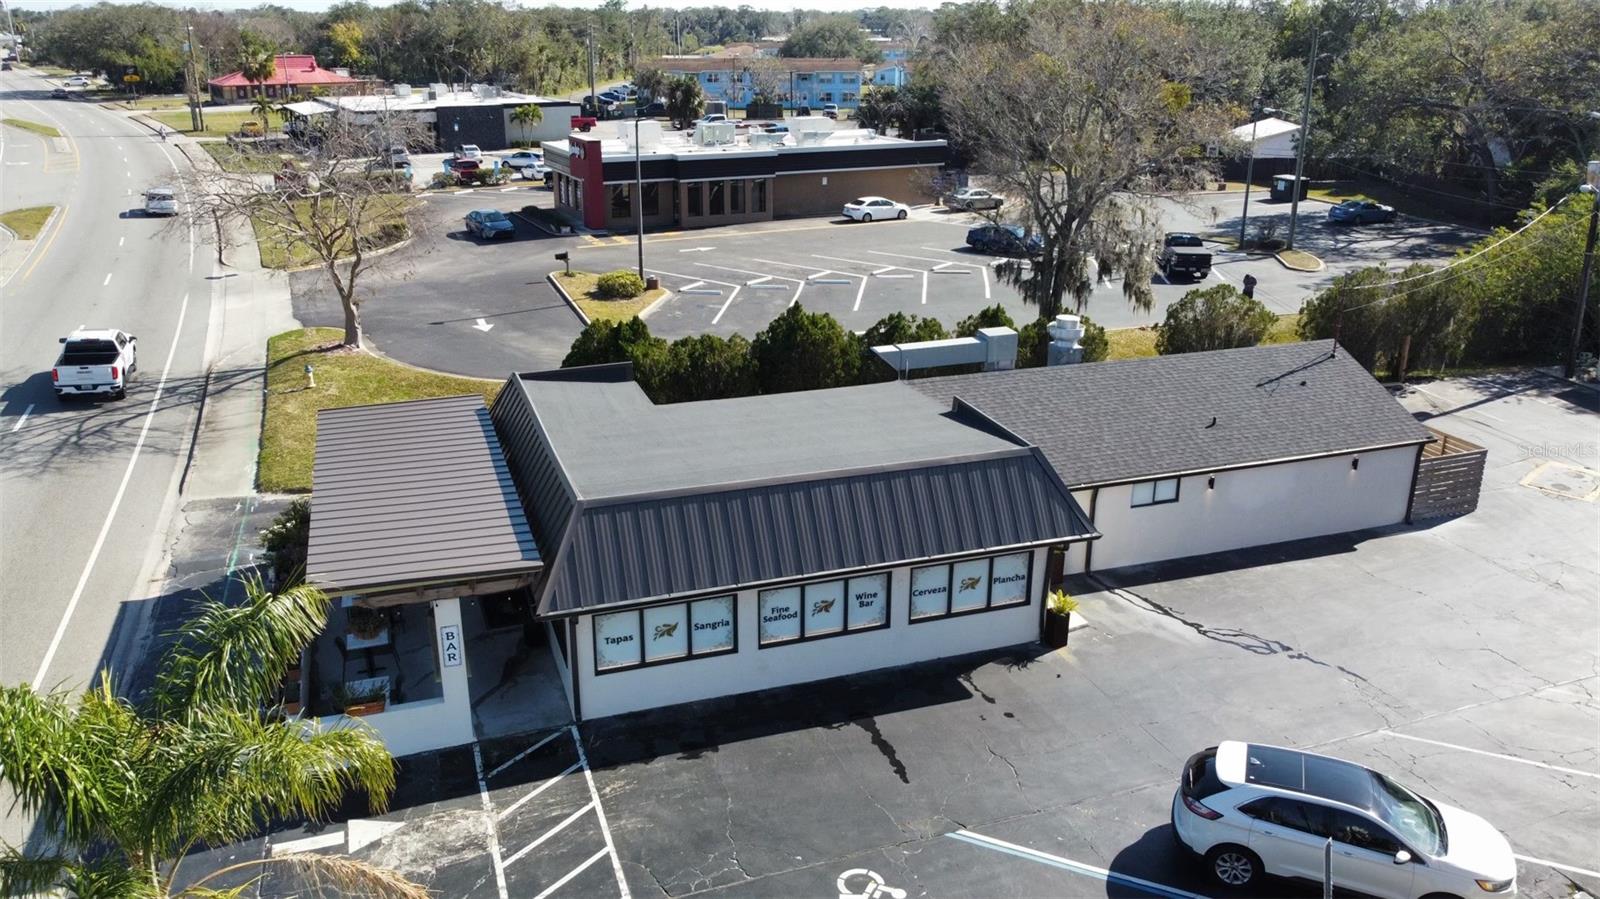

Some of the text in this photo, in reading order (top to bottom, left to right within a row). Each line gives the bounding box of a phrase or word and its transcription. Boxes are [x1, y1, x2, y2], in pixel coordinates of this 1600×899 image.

[993, 574, 1026, 584] Plancha
[855, 591, 878, 601] Wine
[912, 586, 947, 597] Cerveza
[859, 600, 874, 608] Bar
[771, 606, 790, 615] Fine
[763, 611, 798, 623] Seafood
[694, 619, 730, 631] Sangria
[604, 634, 634, 645] Tapas
[445, 631, 457, 661] BAR
